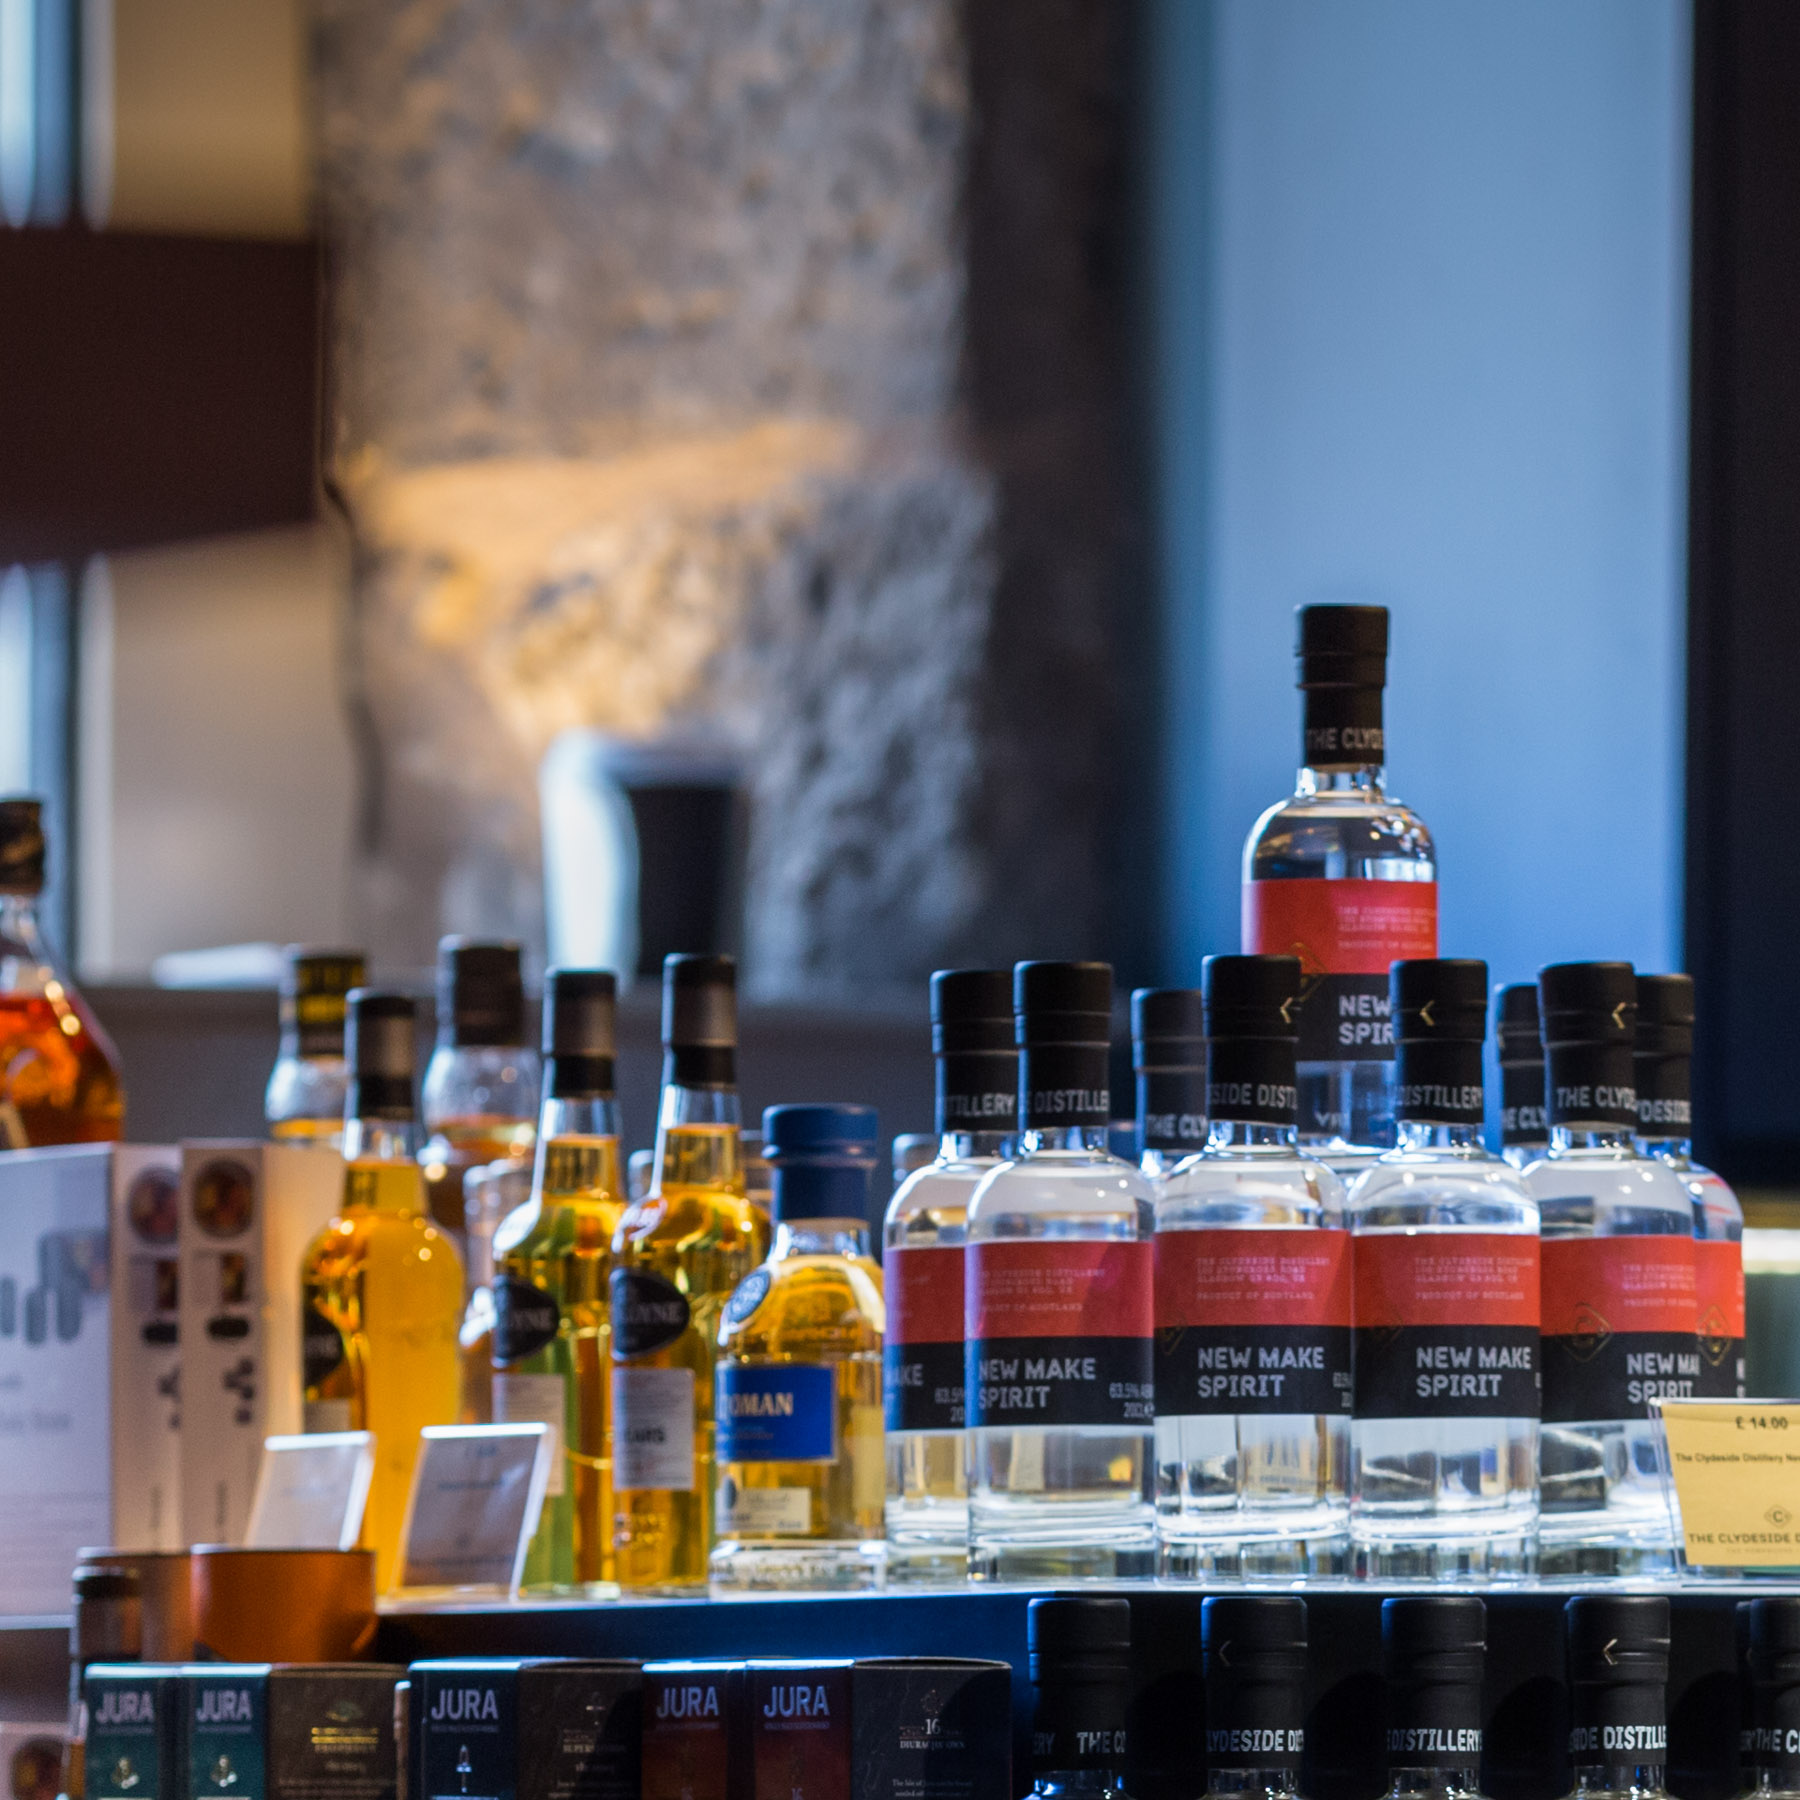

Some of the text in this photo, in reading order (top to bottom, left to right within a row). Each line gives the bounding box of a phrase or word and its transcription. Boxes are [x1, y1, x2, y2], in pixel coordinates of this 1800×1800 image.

[1339, 995, 1391, 1016] NEW
[1198, 1347, 1325, 1369] NEW MAKE
[1417, 1347, 1531, 1368] NEW MAKE
[979, 1358, 1096, 1381] NEW MAKE
[1198, 1375, 1285, 1397] SPIRIT
[1417, 1375, 1501, 1397] SPIRIT
[979, 1386, 1050, 1409] SPIRIT
[1750, 1417, 1788, 1429] 14.00
[1696, 1453, 1740, 1464] Clydeside
[1689, 1533, 1714, 1543] THE
[1718, 1533, 1790, 1543] CLYDESIDE
[96, 1693, 154, 1723] JURA
[196, 1690, 252, 1722] JURA
[430, 1689, 498, 1720] JURA
[656, 1686, 720, 1718] JURA
[763, 1685, 830, 1717] JURA
[1077, 1732, 1111, 1753] THE
